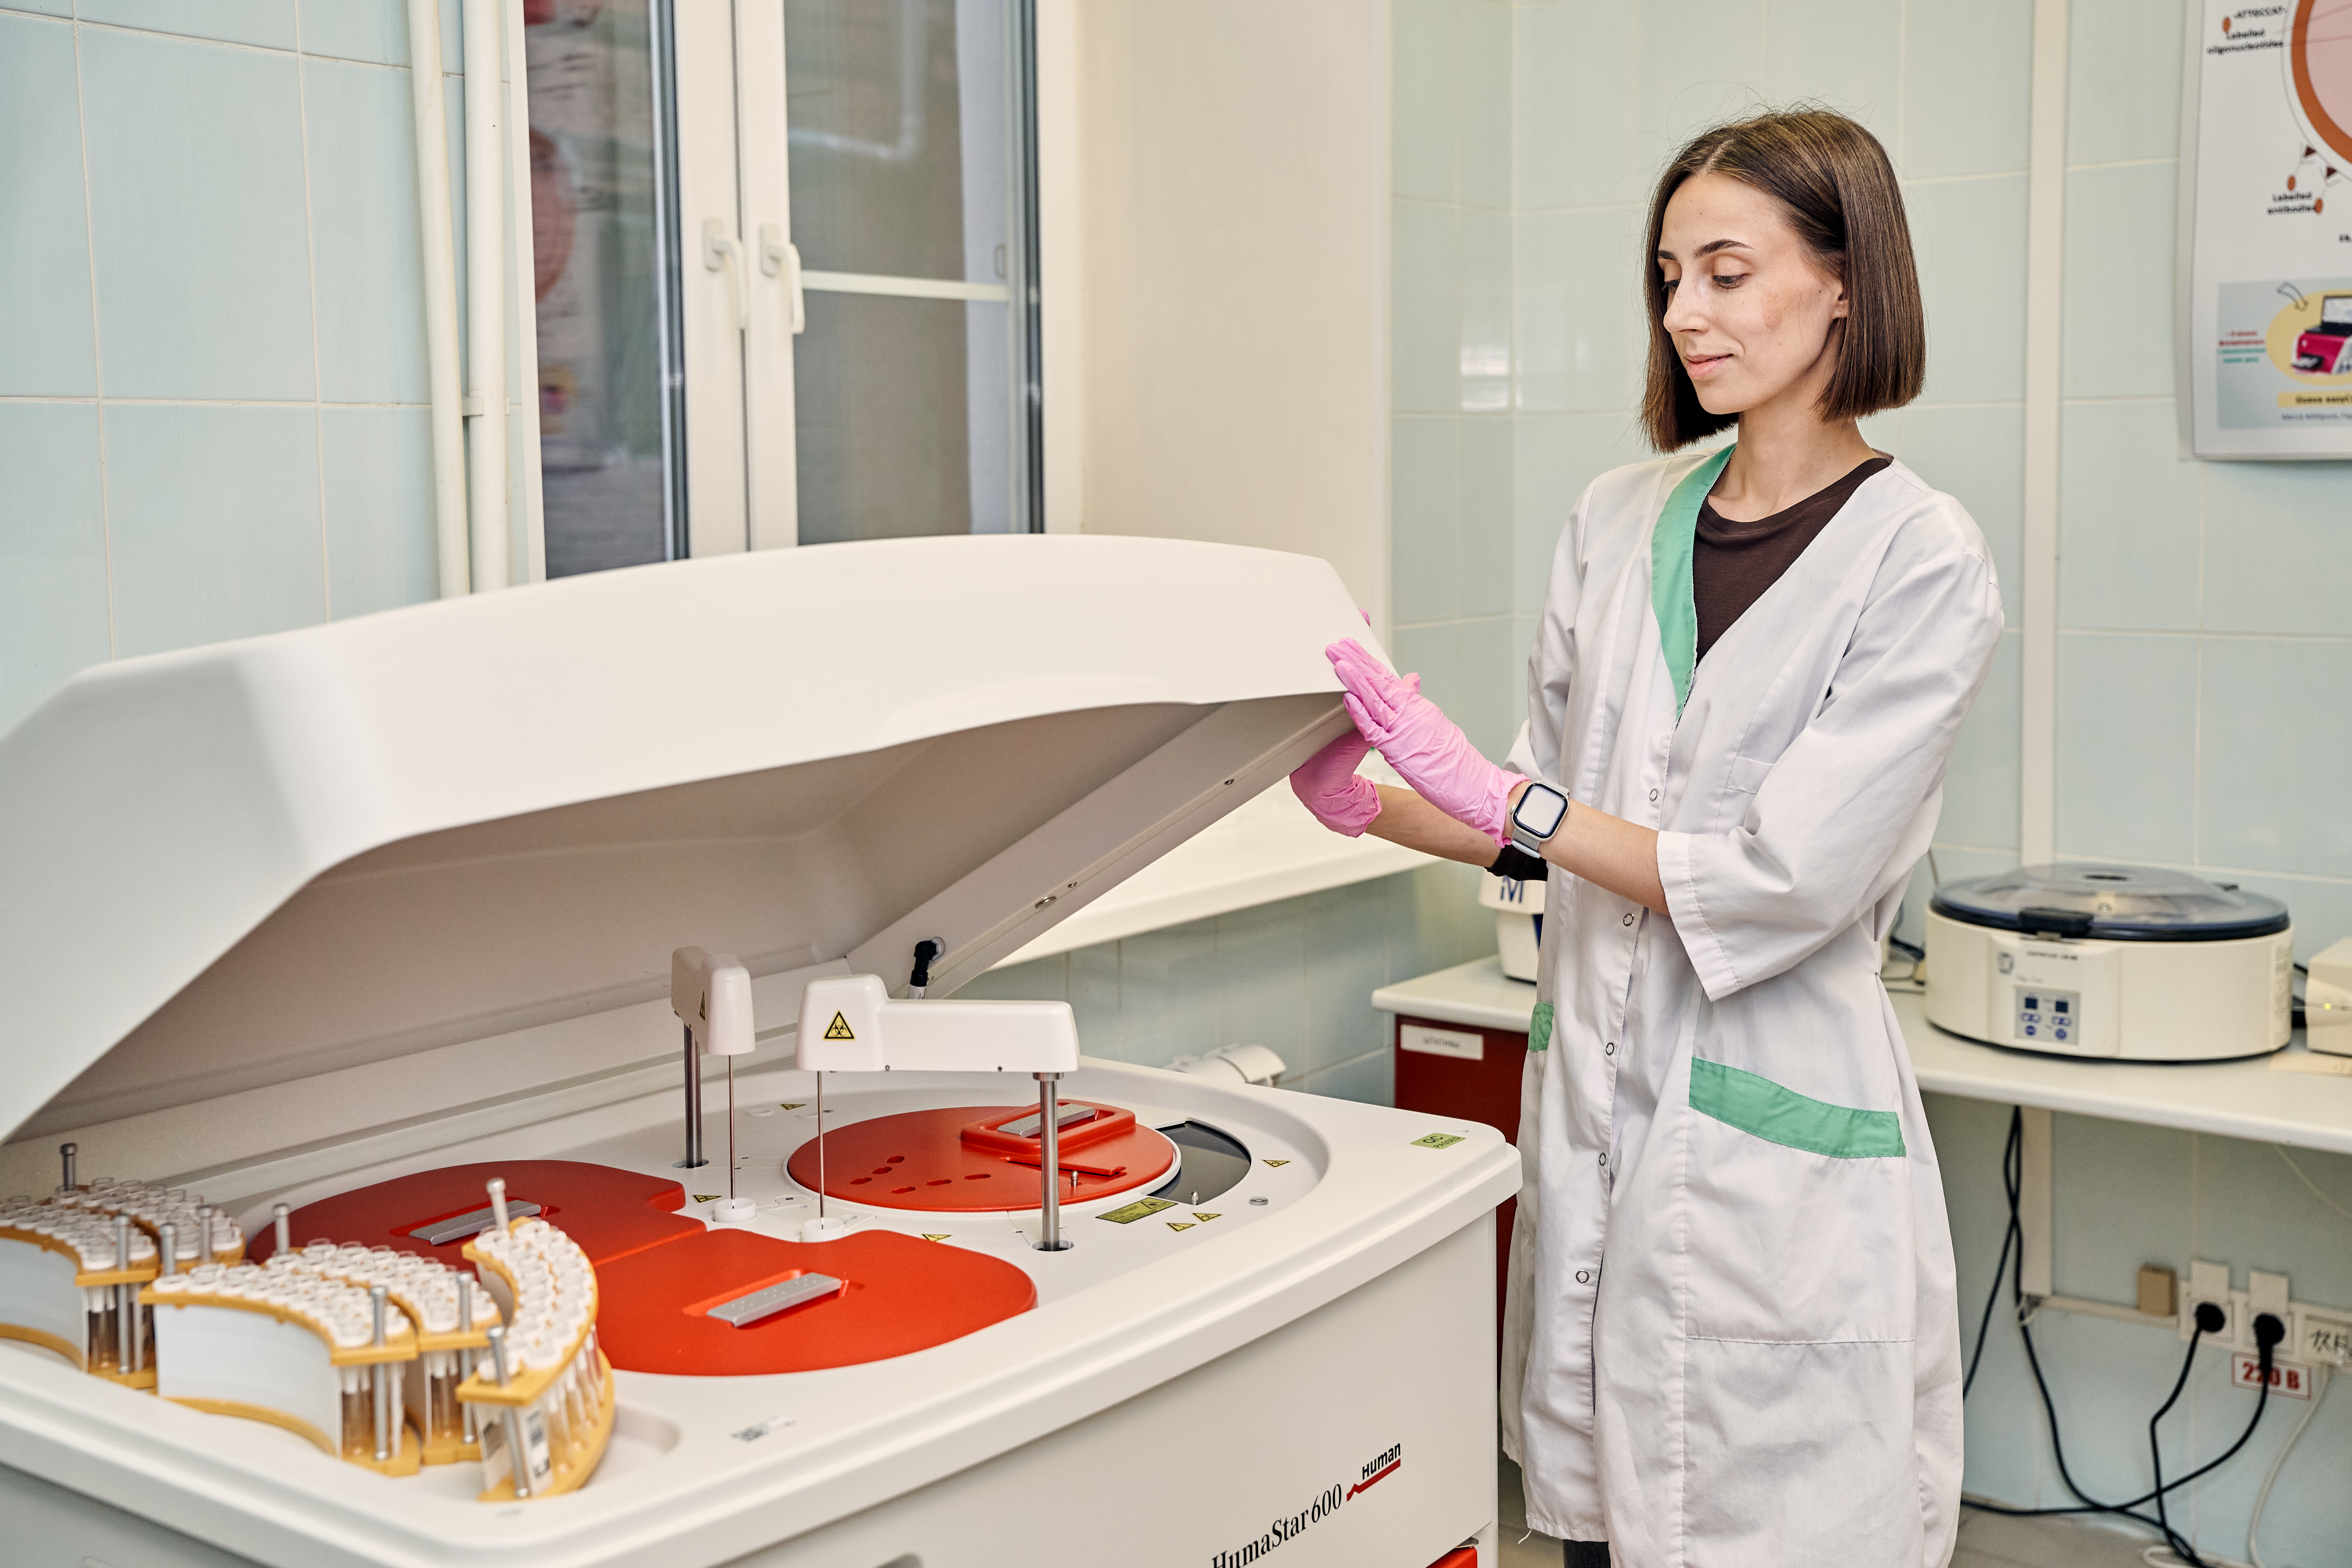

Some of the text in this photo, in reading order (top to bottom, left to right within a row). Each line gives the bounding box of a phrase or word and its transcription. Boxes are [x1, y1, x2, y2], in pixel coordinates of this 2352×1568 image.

[1433, 1136, 1460, 1148] PASSED
[1362, 1443, 1401, 1480] Human
[1311, 1484, 1342, 1523] 600
